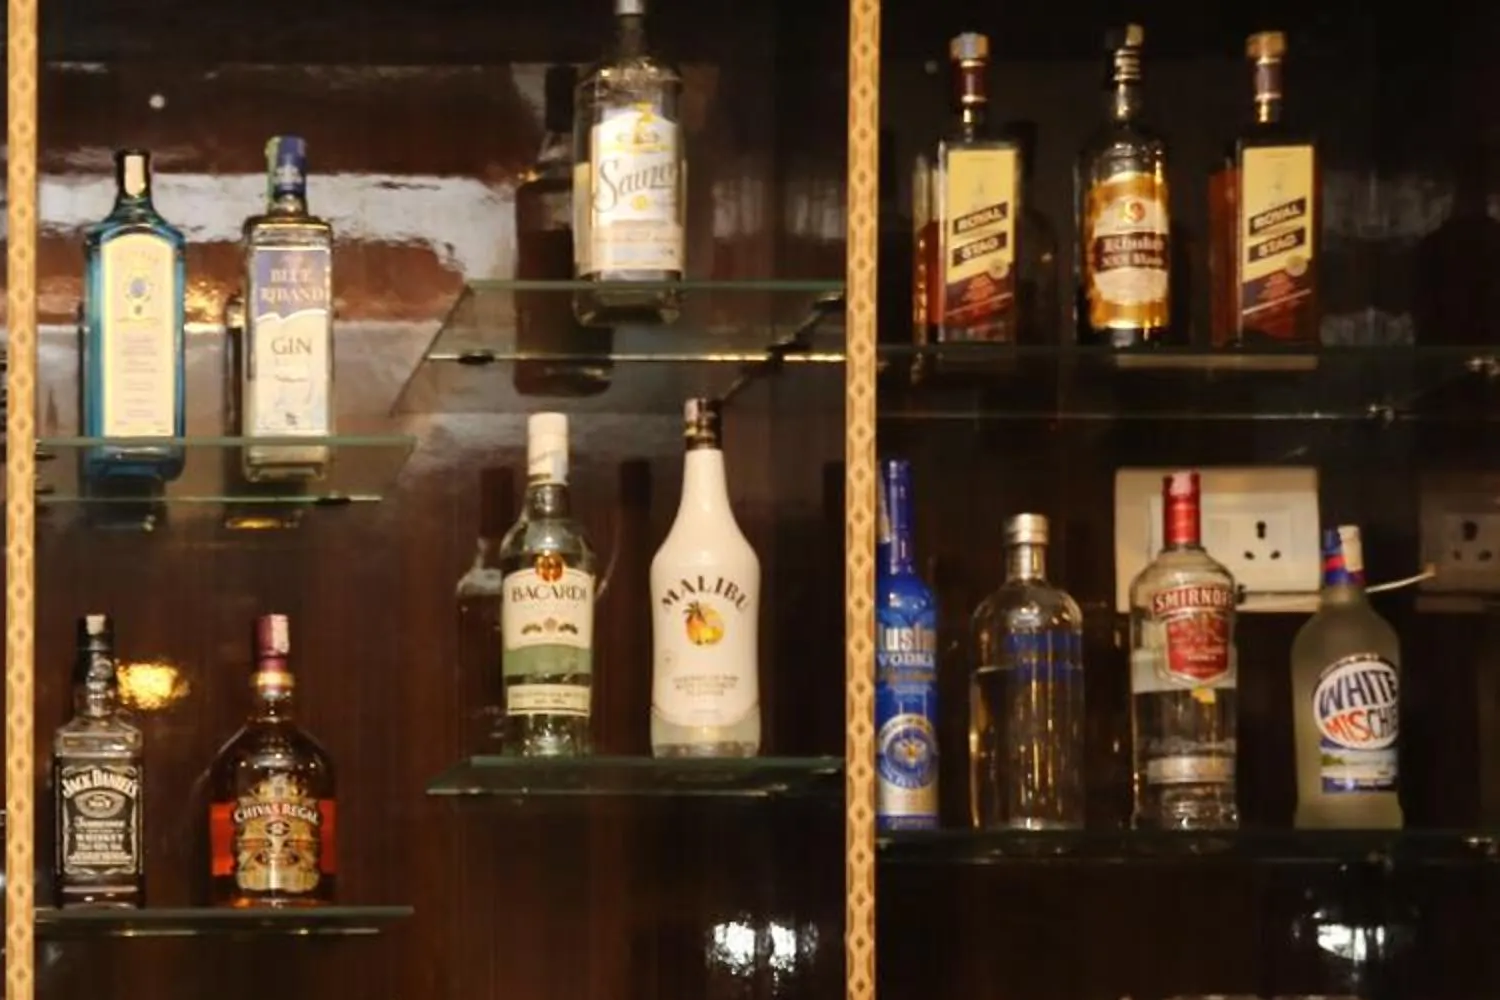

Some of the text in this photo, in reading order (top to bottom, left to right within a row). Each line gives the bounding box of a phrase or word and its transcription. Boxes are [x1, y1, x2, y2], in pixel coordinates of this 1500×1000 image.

[270, 336, 313, 355] GIN
[511, 582, 588, 602] BACARDI
[661, 575, 749, 613] MALIBU
[1319, 669, 1397, 720] WHITE
[62, 773, 93, 799] JACK
[233, 802, 319, 826] CHIVAS REGAL
